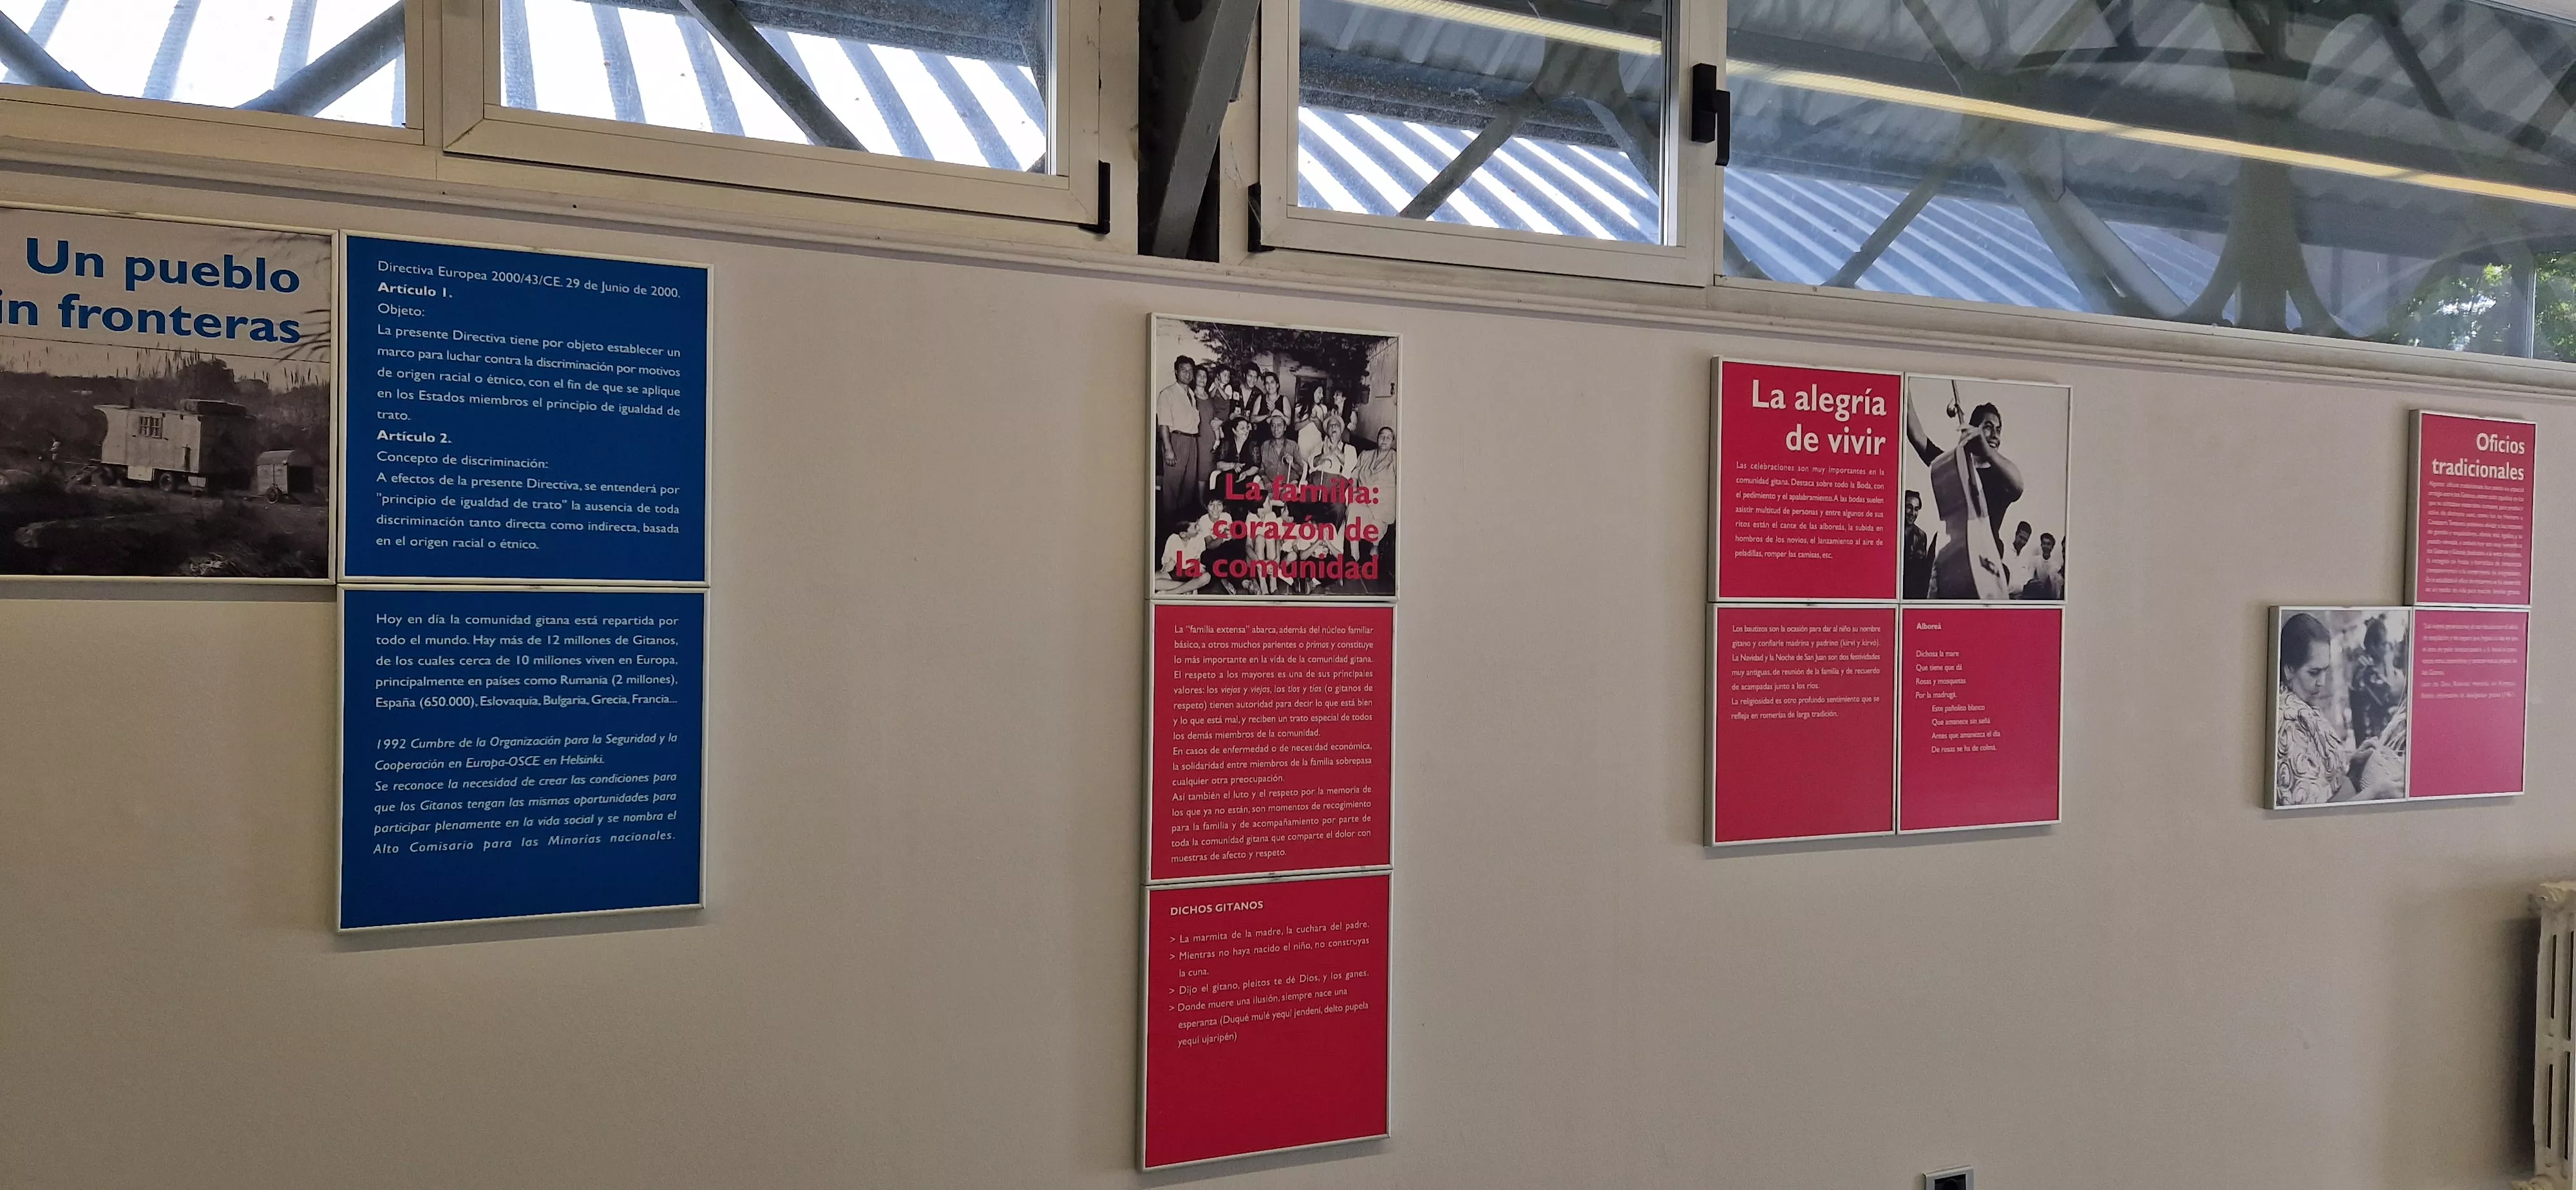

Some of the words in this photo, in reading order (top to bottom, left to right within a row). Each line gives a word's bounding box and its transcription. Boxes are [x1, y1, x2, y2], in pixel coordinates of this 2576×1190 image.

[26, 237, 104, 278] Un
[126, 254, 300, 293] pueblo
[378, 260, 434, 276] Directiva
[439, 266, 487, 281] Europea
[492, 270, 563, 287] 2000/43/CE.
[566, 278, 580, 288] 29
[583, 279, 598, 290] de
[600, 281, 630, 294] Junio
[634, 285, 647, 295] de
[651, 286, 680, 298] 2000.
[377, 282, 436, 296] Artículo
[443, 287, 452, 298] 1.
[0, 289, 38, 325] n
[58, 294, 301, 344] fronteras
[378, 303, 424, 317] Objeto:
[378, 324, 392, 335] La
[395, 328, 448, 339] presente
[453, 330, 506, 343] Directiva
[510, 335, 539, 346] tiene
[542, 340, 564, 349] por
[567, 339, 604, 352] objeto
[607, 344, 664, 355] establecer
[1752, 379, 1786, 410] La
[1794, 384, 1888, 422] alegría
[377, 411, 411, 420] trato.
[377, 430, 435, 442] Artículo
[440, 433, 451, 443] 2.
[1786, 423, 1819, 451] de
[1827, 426, 1886, 456] vivir
[2476, 432, 2525, 455] Oficios
[377, 451, 438, 466] Concepto
[442, 454, 457, 464] de
[461, 455, 548, 468] discriminación:
[1750, 462, 1794, 471] celebraciones
[1828, 466, 1866, 475] importantes
[2432, 458, 2524, 480] tradicionales
[376, 472, 387, 482] A
[392, 473, 435, 484] efectos
[439, 475, 454, 485] de
[458, 475, 468, 486] la
[471, 479, 523, 488] presente
[527, 478, 582, 491] Directiva,
[600, 483, 657, 493] entenderá
[660, 487, 680, 496] por
[1226, 474, 1262, 501] La
[1273, 475, 1379, 504] familia:
[1213, 516, 1334, 541] corazón
[1345, 516, 1379, 542] de
[1176, 551, 1202, 578] la
[1213, 554, 1379, 580] comunidad
[375, 676, 464, 689] principalmente
[486, 676, 520, 688] países
[612, 675, 623, 686] (2
[626, 674, 677, 686] millones),
[1741, 683, 1773, 692] acampadas
[1774, 683, 1790, 692] junto
[376, 697, 416, 710] España
[420, 697, 478, 710] (650.000),
[480, 695, 541, 708] Eslovaquia,
[544, 695, 590, 708] Bulgaria,
[591, 694, 630, 704] Grecia,
[632, 694, 677, 703] Francia...
[1173, 732, 1185, 740] los
[1188, 731, 1213, 739] demás
[1215, 730, 1255, 739] miembros
[1257, 730, 1266, 738] de
[1269, 729, 1274, 737] la
[1173, 747, 1183, 755] En
[1210, 746, 1220, 754] de
[1222, 744, 1269, 753] enfermedad
[1279, 744, 1289, 752] de
[1291, 742, 1328, 751] necesidad
[375, 759, 444, 773] Cooperación
[466, 756, 540, 770] Europa-OSCE
[560, 755, 605, 765] Helsinki.
[1172, 777, 1209, 788] cualquier
[374, 804, 395, 815] que
[400, 801, 415, 811] los
[420, 800, 462, 810] Gitanos
[468, 800, 505, 811] tengan
[509, 797, 524, 807] las
[528, 797, 570, 806] mismas
[574, 793, 649, 807] oportunidades
[653, 793, 676, 804] para
[373, 844, 399, 854] Alto
[410, 841, 473, 853] Comisario
[483, 840, 512, 851] para
[522, 837, 538, 847] las
[547, 835, 601, 845] Minorías
[611, 831, 675, 842] nacionales.
[1171, 855, 1208, 863] muestras
[1210, 851, 1220, 860] de
[1222, 851, 1246, 859] afecto
[1249, 852, 1253, 860] y
[1171, 904, 1212, 916] DICHOS
[1215, 901, 1263, 912] GITANOS
[1180, 934, 1189, 943] La
[1193, 932, 1227, 942] marmita
[1231, 930, 1242, 939] de
[1245, 929, 1252, 938] la
[1287, 926, 1293, 934] la
[1296, 924, 1327, 933] cuchara
[1330, 921, 1342, 930] del
[1179, 968, 1186, 978] la
[1178, 1001, 1206, 1012] Donde
[1282, 992, 1312, 1002] siempre
